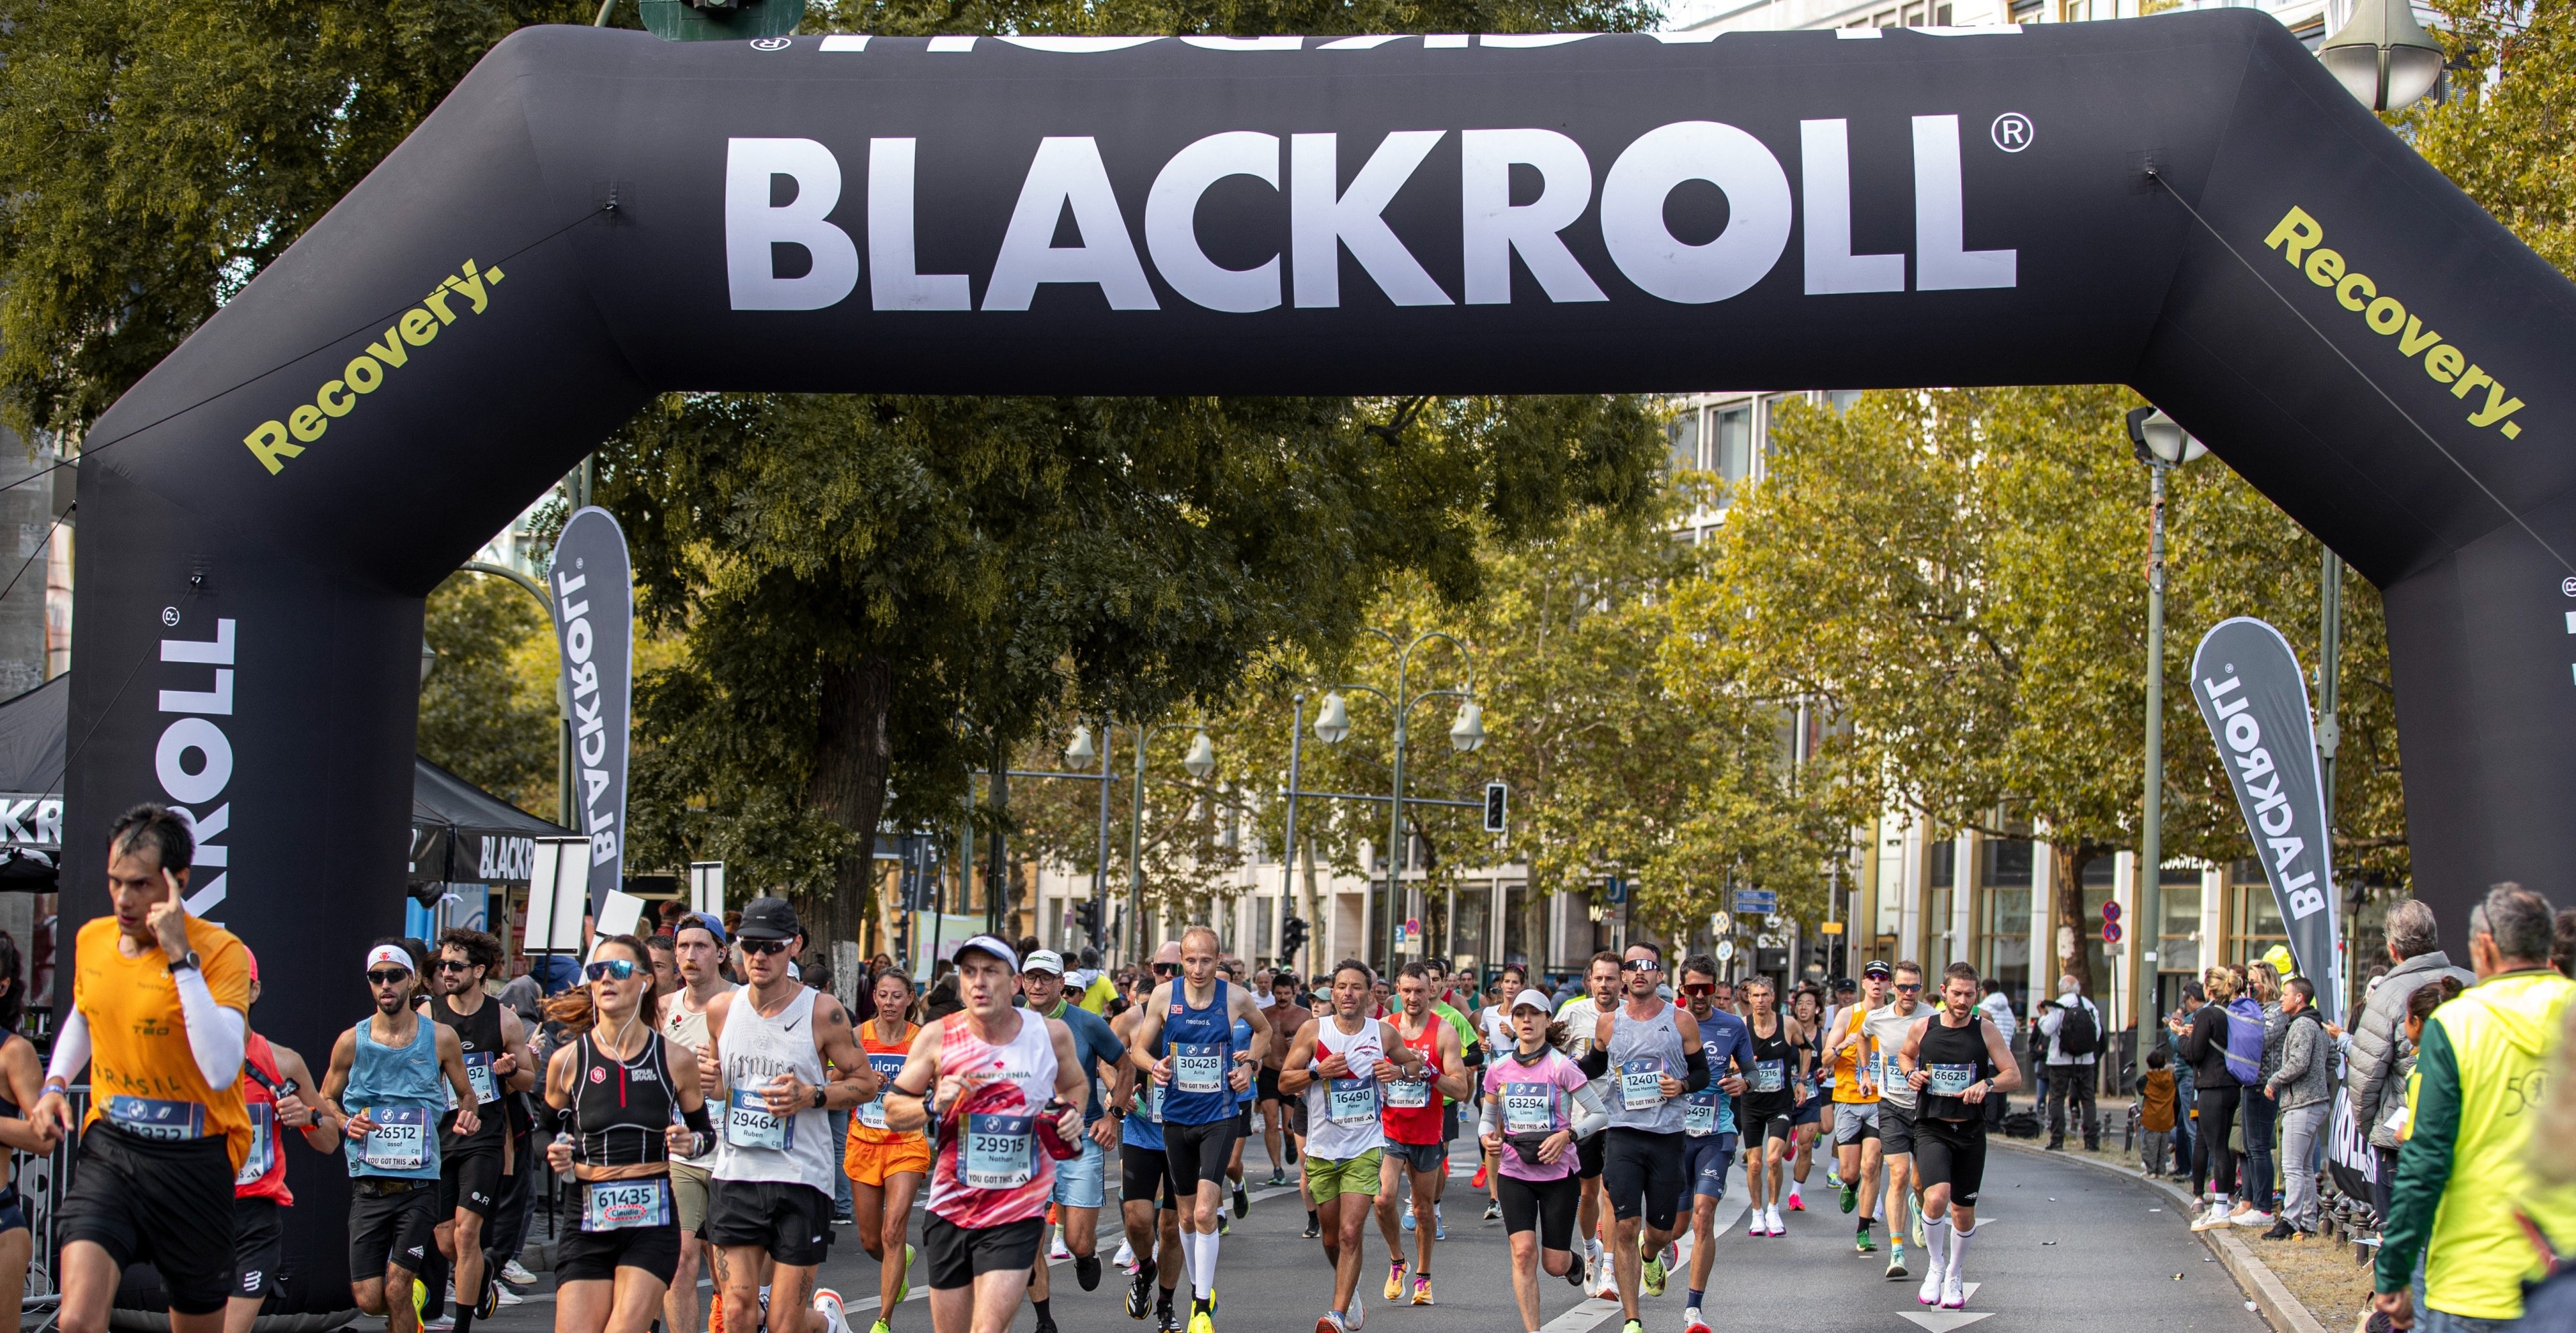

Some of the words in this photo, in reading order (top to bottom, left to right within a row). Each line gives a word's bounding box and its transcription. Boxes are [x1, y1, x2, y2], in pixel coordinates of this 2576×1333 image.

[725, 114, 2017, 313] BLACKROLL
[2264, 205, 2526, 441] Recovery.
[244, 258, 504, 476] Recovery.
[1180, 1058, 1218, 1069] 30428
[1627, 1073, 1658, 1086] 12401
[1934, 1070, 1967, 1081] 66628
[1335, 1090, 1371, 1104] 16490
[1509, 1098, 1544, 1108] 63294
[733, 1111, 780, 1130] 29464
[375, 1126, 416, 1139] 26512
[743, 1130, 763, 1138] Ruben
[976, 1136, 1025, 1153] 29915
[968, 1174, 982, 1183] YOU
[983, 1175, 998, 1184] GOT
[1000, 1175, 1014, 1183] THIS
[598, 1187, 651, 1208] 61435
